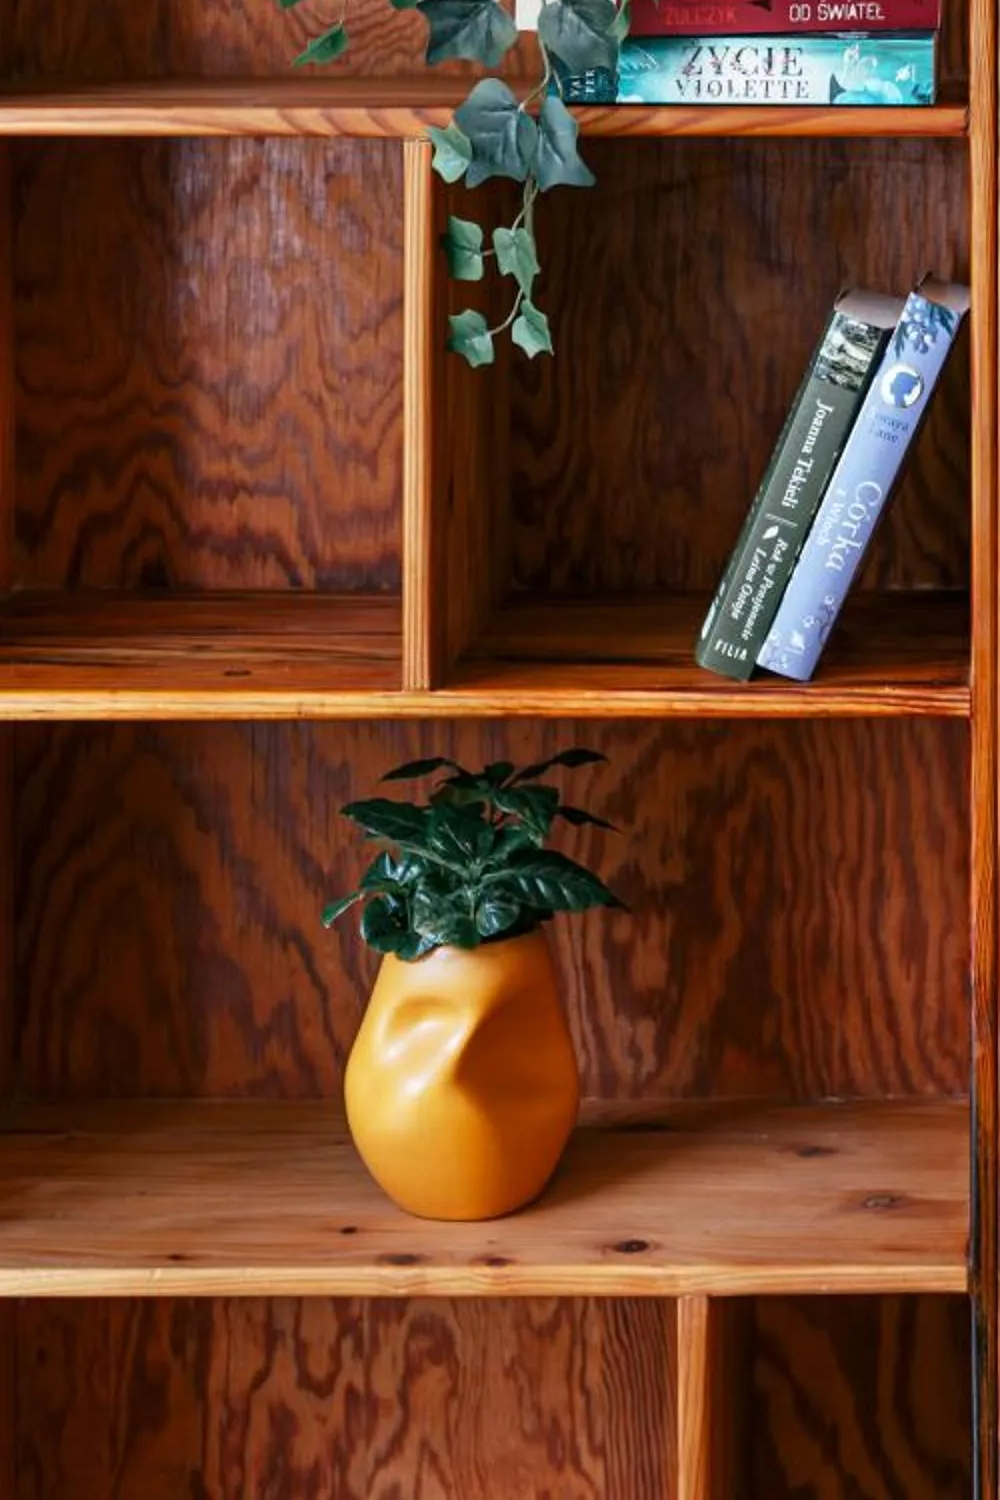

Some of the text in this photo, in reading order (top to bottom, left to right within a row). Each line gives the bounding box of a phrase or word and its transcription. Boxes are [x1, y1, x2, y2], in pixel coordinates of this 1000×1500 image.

[788, 0, 886, 23] OD ŚWIATEŁ
[675, 78, 810, 100] VIOLETTE
[781, 398, 835, 510] Joanna Tekieli
[827, 480, 883, 570] Córka
